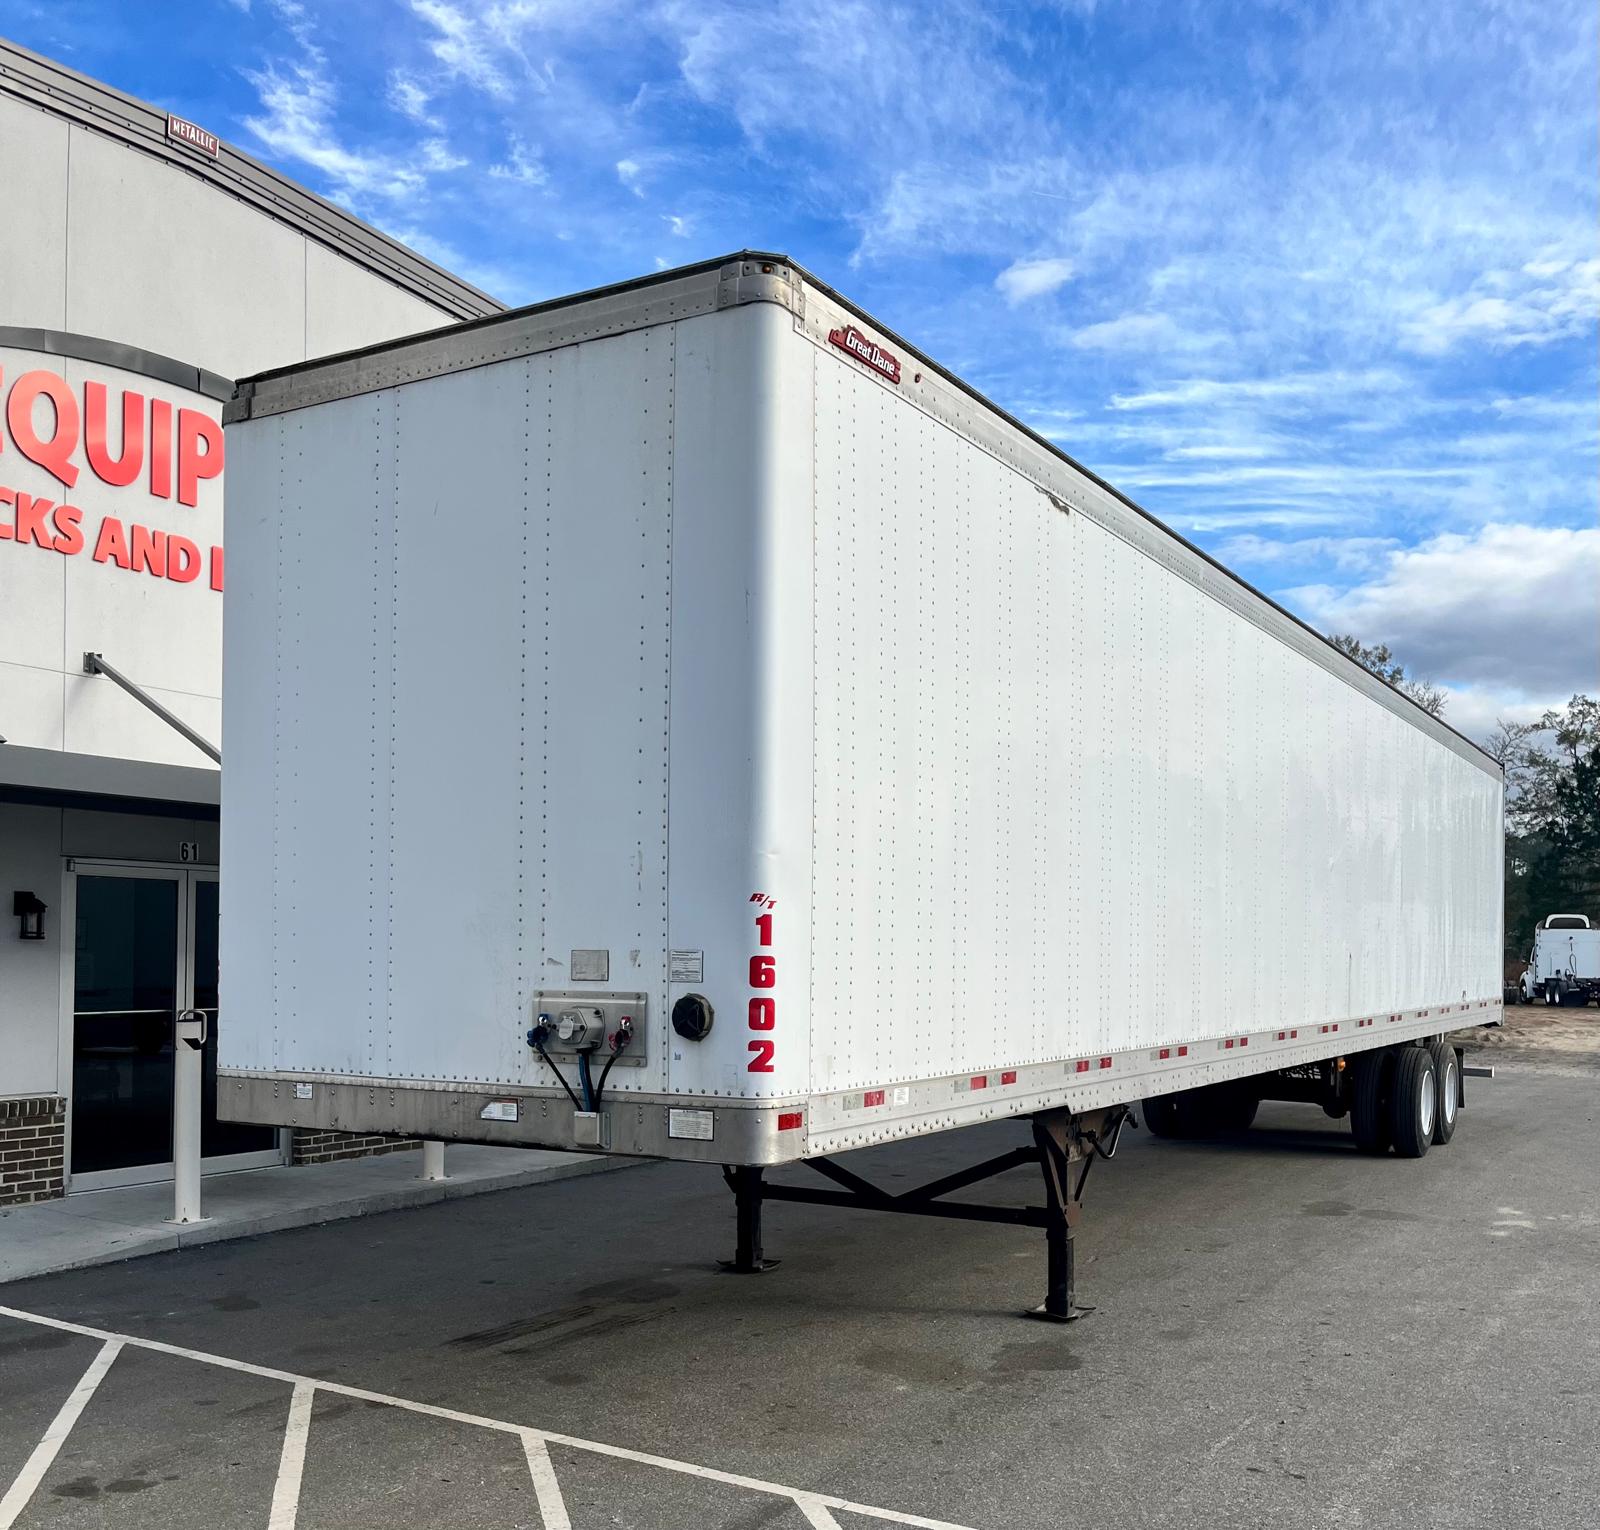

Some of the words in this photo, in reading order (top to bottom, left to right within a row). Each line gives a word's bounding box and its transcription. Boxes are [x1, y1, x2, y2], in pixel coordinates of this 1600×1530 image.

[173, 119, 215, 150] METALLIC
[845, 330, 872, 360] Great
[871, 346, 895, 375] Dane
[0, 365, 224, 508] QUIP
[93, 516, 201, 583] AND
[180, 842, 198, 861] 61
[749, 893, 777, 909] R/T
[747, 913, 776, 1073] 1602
